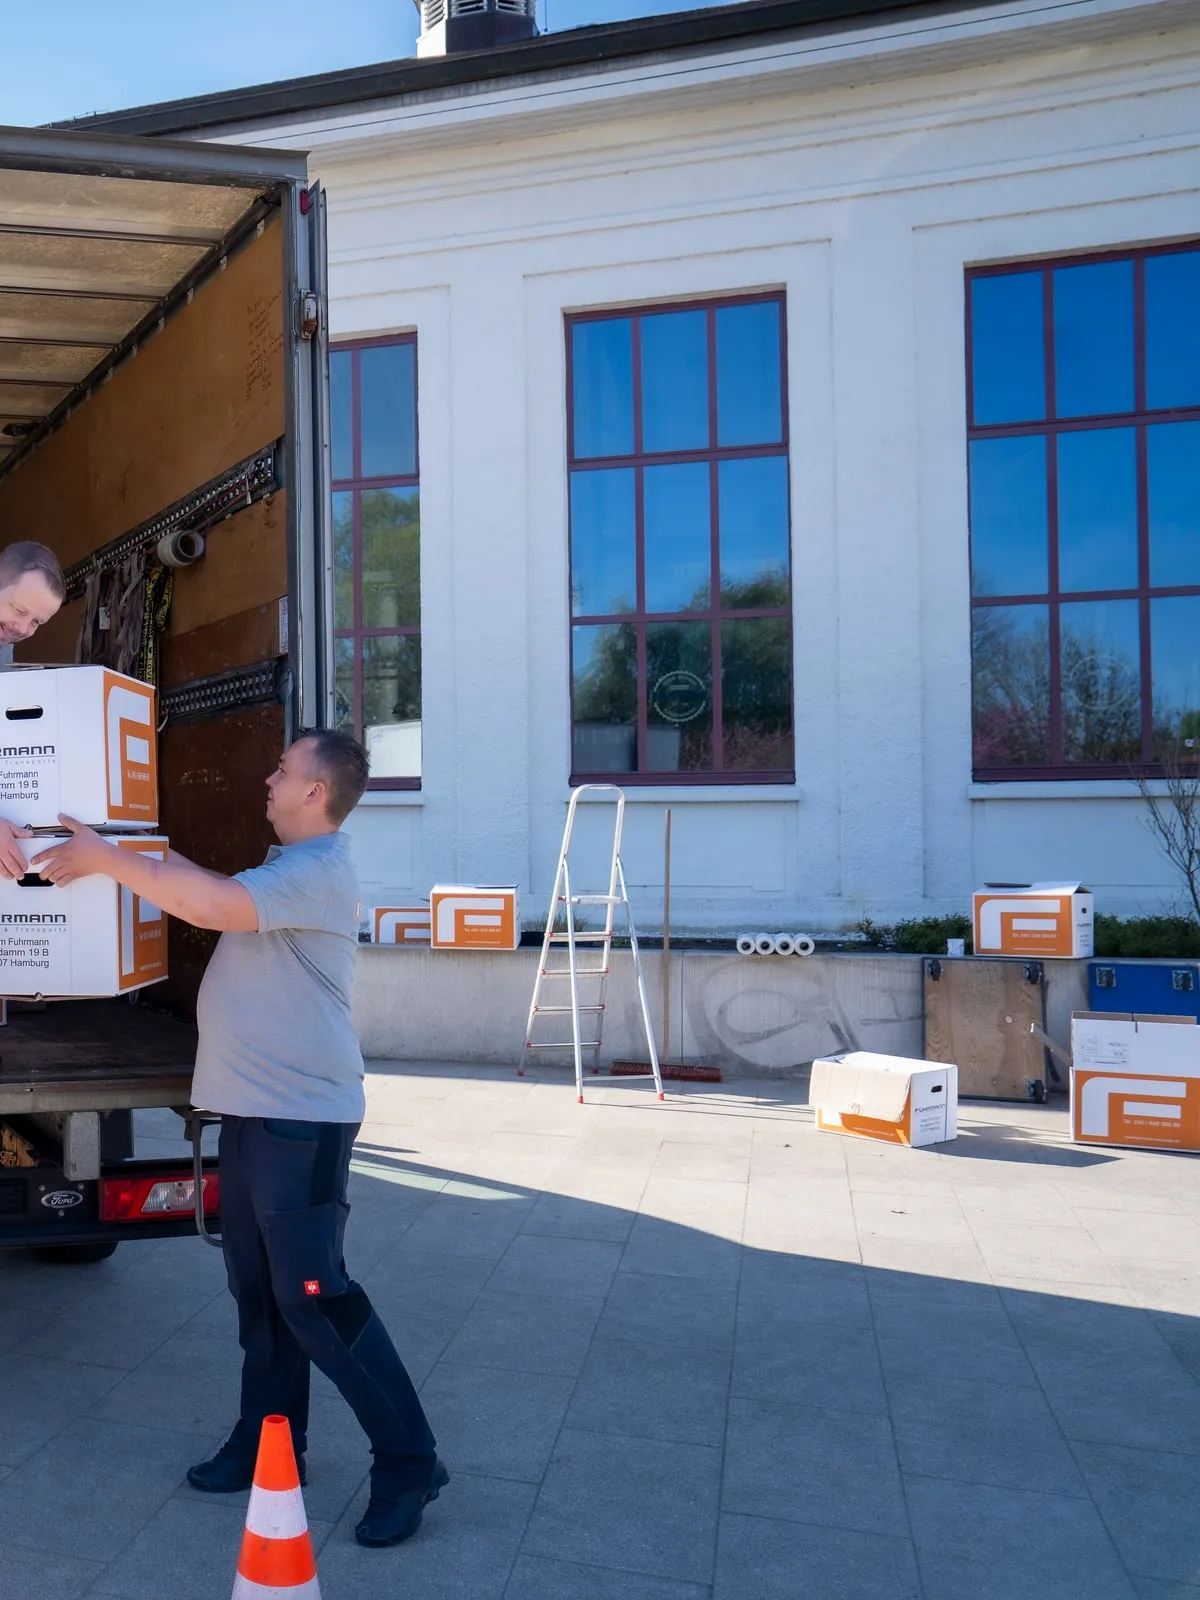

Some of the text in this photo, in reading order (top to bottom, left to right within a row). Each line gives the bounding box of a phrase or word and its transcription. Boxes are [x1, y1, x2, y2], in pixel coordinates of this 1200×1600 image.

[19, 780, 29, 789] 19
[31, 780, 39, 788] B
[0, 791, 39, 801] Hamburg
[8, 937, 50, 946] Fuhrmann
[29, 948, 39, 957] 19
[42, 948, 49, 957] B
[10, 959, 50, 969] Hamburg
[50, 1194, 75, 1205] Ford
